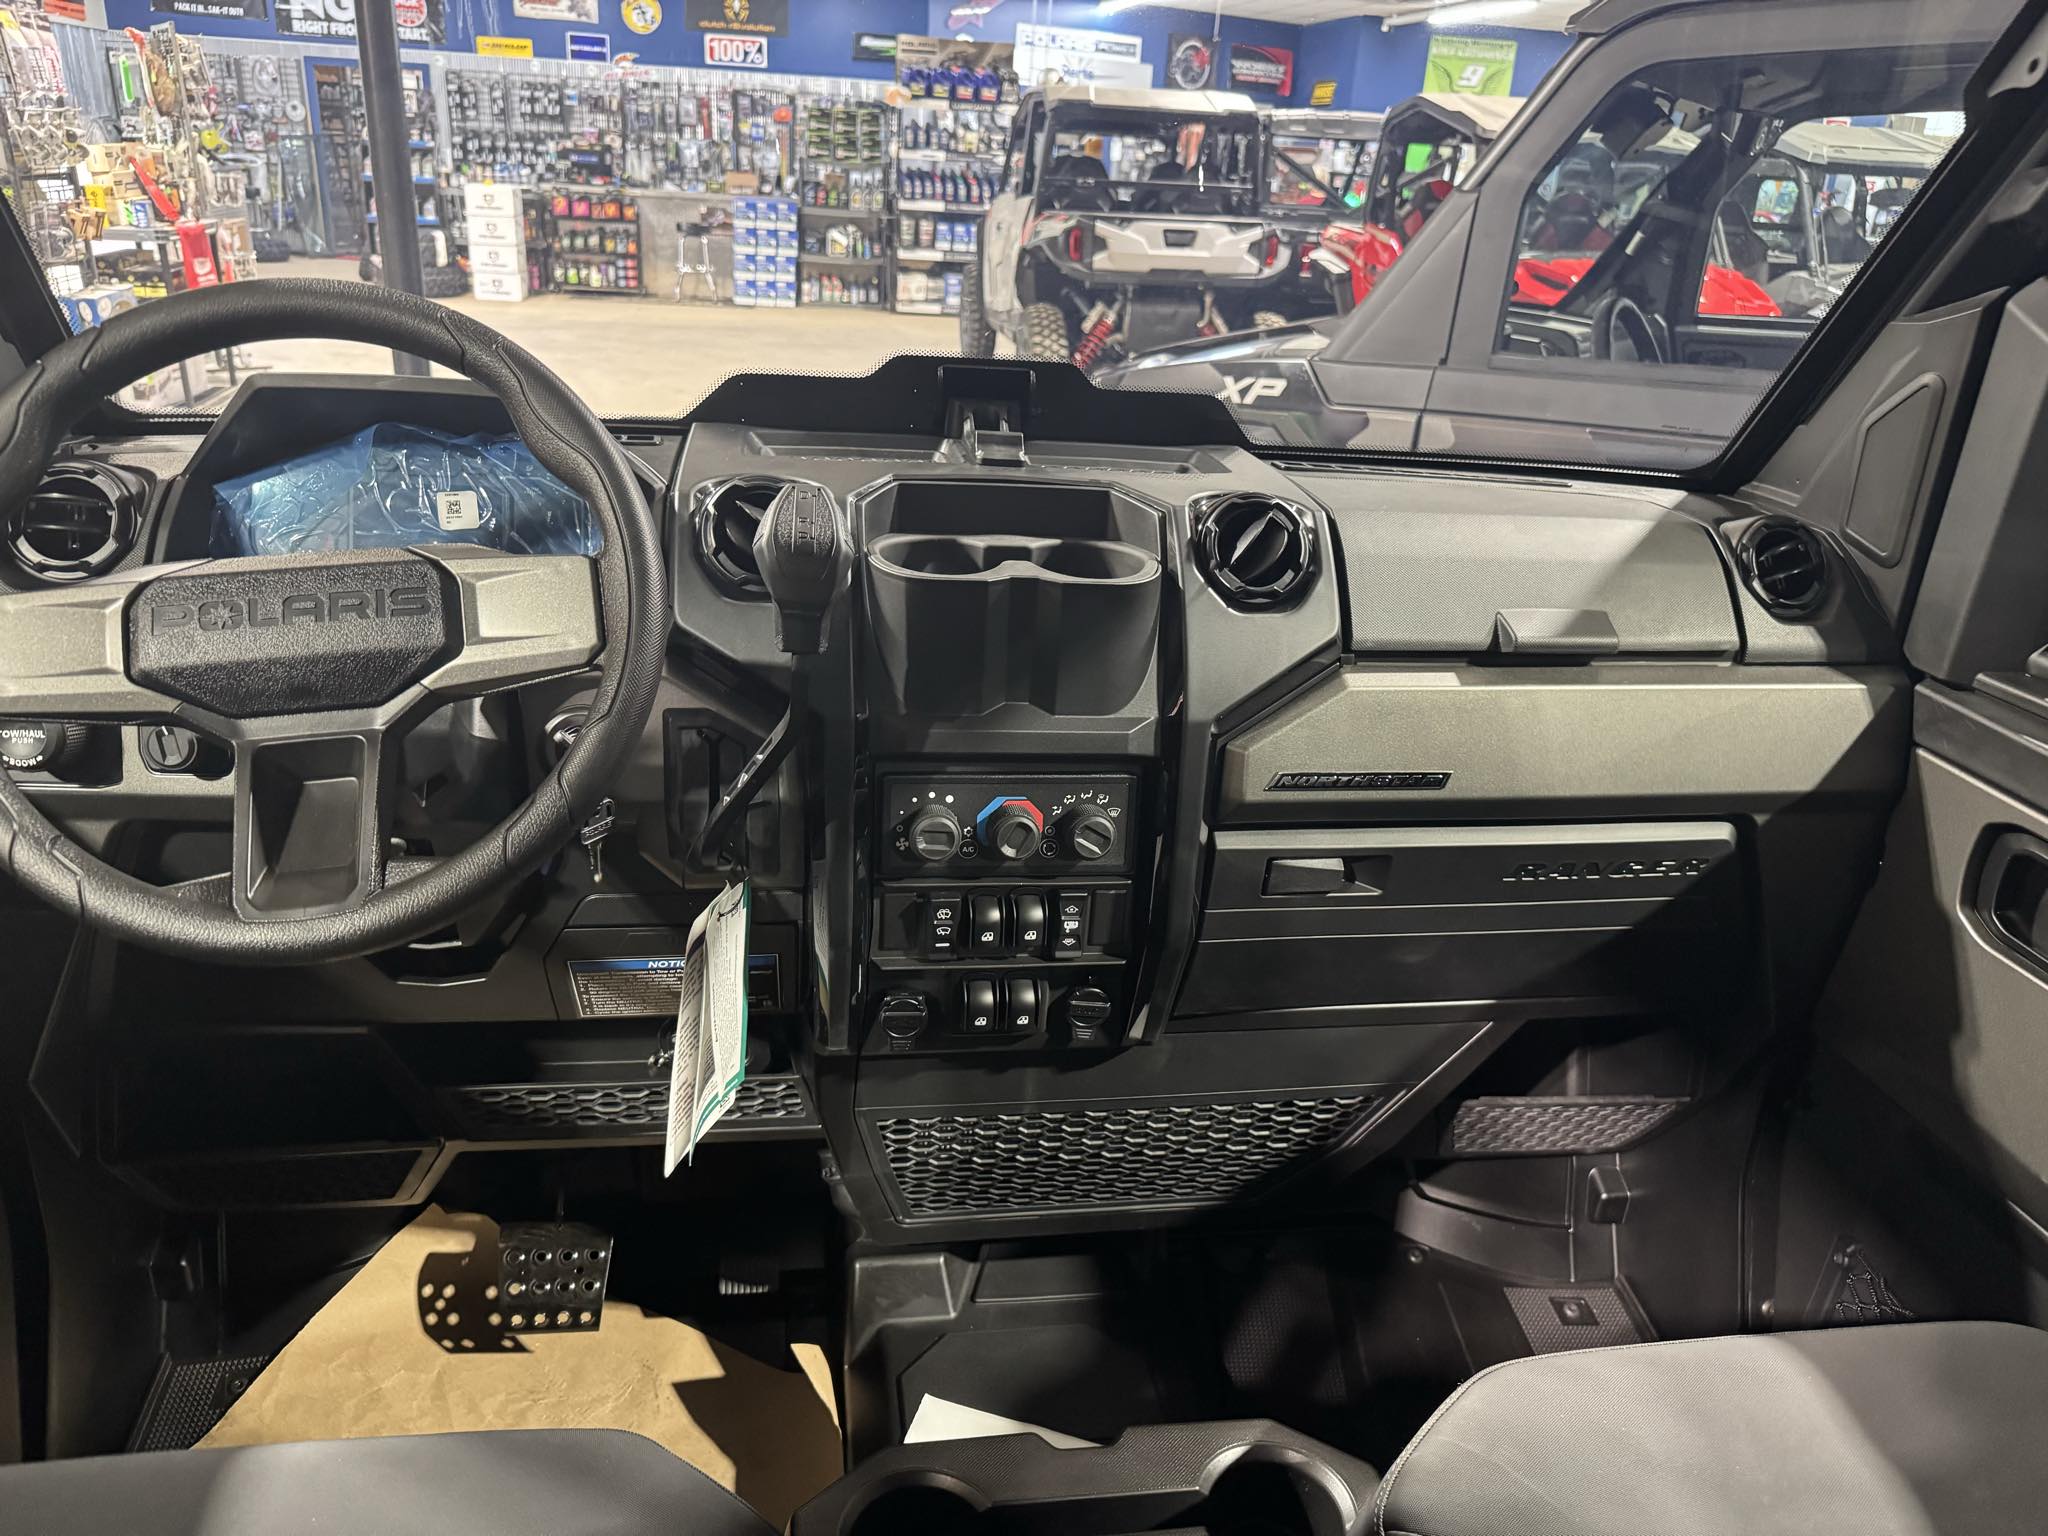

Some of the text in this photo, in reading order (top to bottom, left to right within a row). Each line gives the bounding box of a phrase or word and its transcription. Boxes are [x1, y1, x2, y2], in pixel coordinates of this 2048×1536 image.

[291, 19, 431, 41] RIGHT FRO TART.
[709, 39, 764, 64] 100%
[1454, 63, 1488, 88] 9
[1216, 376, 1288, 405] XP
[151, 586, 432, 637] POLARIS
[0, 729, 46, 738] OW/HAUL
[1277, 774, 1445, 787] NORTHSTAR
[1502, 858, 1710, 881] RANGER
[647, 960, 686, 968] NOTIC
